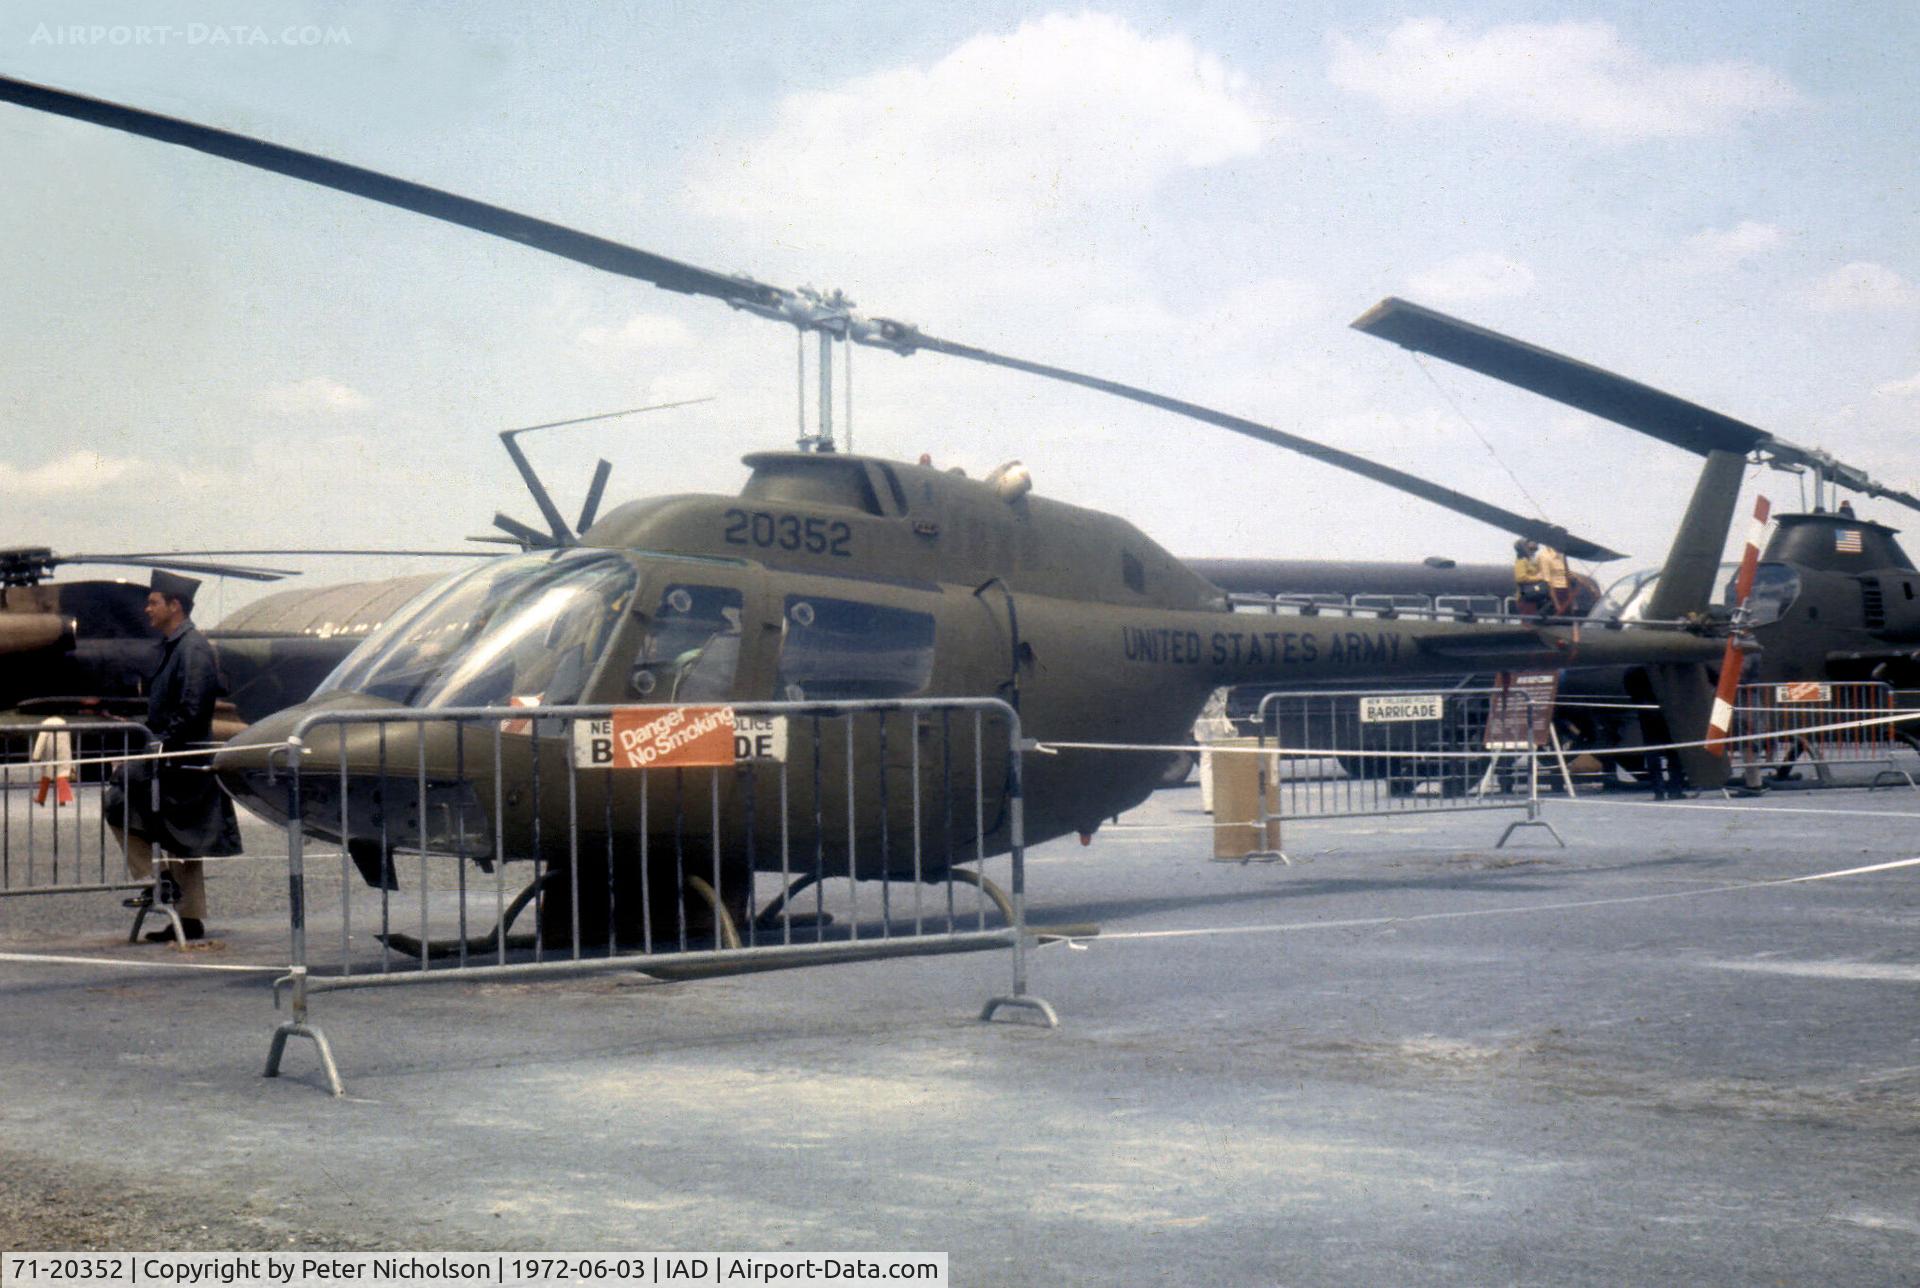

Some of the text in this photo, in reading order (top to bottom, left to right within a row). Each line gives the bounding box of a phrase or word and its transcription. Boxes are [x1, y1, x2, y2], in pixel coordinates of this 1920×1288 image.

[724, 508, 851, 557] 20352
[1122, 627, 1400, 665] UNITED STATES ARMY
[590, 721, 612, 735] NE
[619, 707, 686, 751] Danger
[1367, 704, 1437, 720] BARRICADE
[627, 746, 657, 768] No
[655, 706, 736, 755] Smoking
